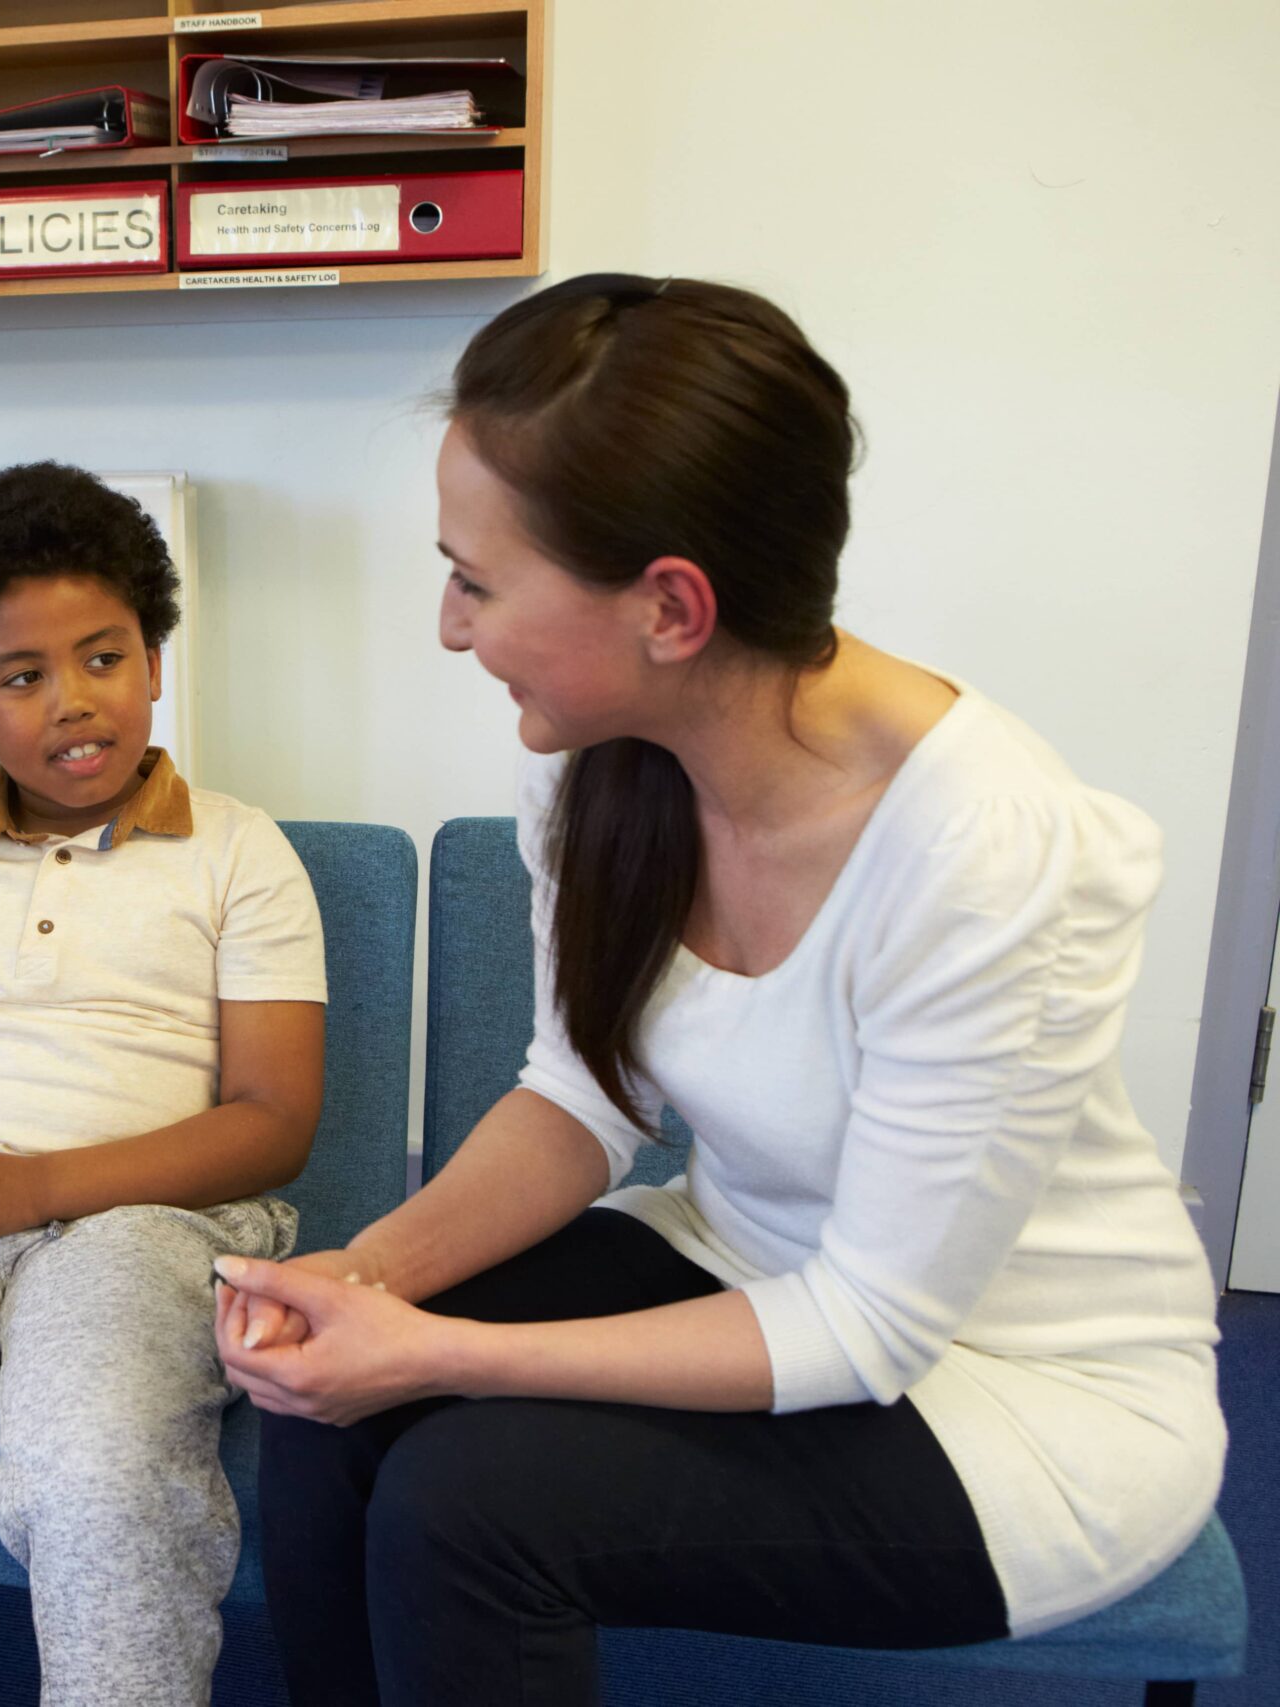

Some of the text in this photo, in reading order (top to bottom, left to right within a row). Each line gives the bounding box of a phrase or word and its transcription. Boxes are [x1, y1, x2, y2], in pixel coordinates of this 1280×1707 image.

[180, 17, 257, 28] STAFF HANDBOOK
[217, 203, 287, 216] Caretaking
[217, 223, 380, 235] Health and Safety Concerns Log
[186, 273, 336, 286] CARETAKERS HEALTH & SAFETY LOG
